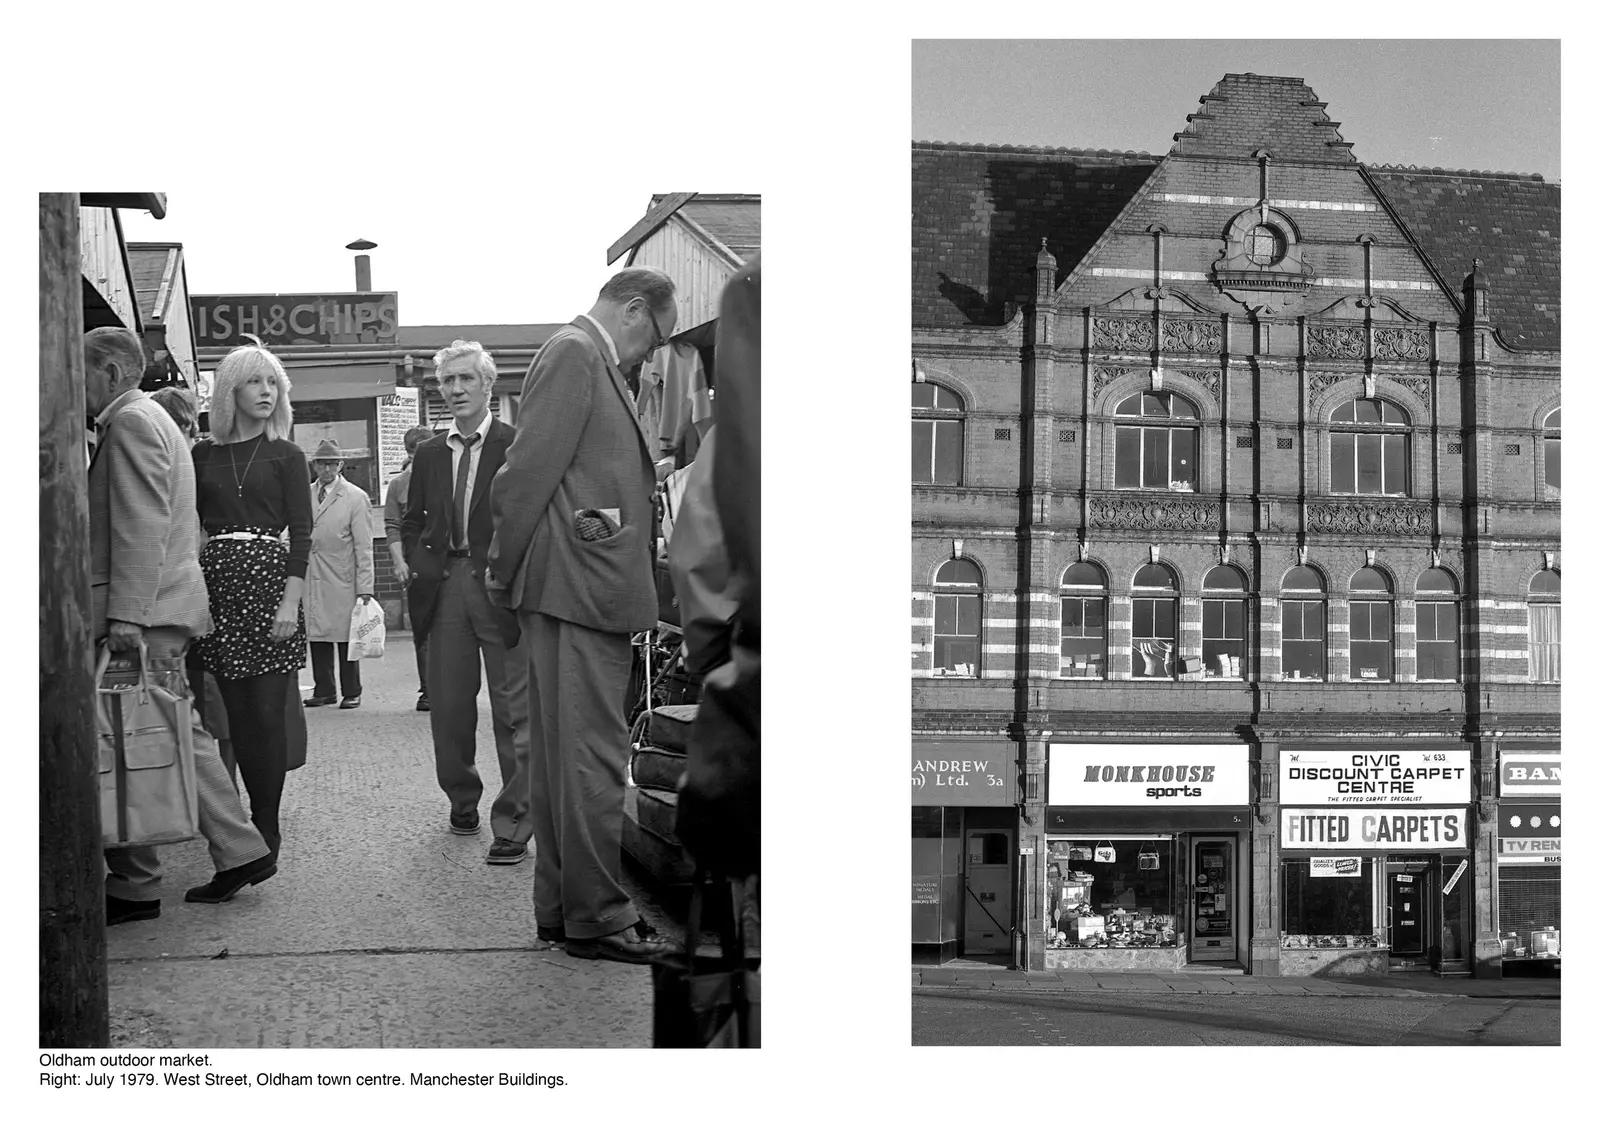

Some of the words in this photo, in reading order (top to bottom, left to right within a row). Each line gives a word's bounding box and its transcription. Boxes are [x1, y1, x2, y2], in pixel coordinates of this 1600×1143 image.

[199, 303, 397, 339] ISH&CHIPS
[913, 760, 989, 772] ANDREW
[1352, 754, 1400, 767] CIVIC
[1083, 765, 1216, 782] MONKHOUSE
[1289, 768, 1384, 780] DISCOUNT
[1390, 768, 1465, 780] CARPET
[936, 774, 969, 786] Ltd.
[986, 774, 1004, 786] 3a
[1146, 785, 1202, 800] sports
[1337, 781, 1414, 793] CENTRE
[1289, 815, 1349, 842] FITTED
[1361, 815, 1459, 842] CARPETS
[1506, 841, 1528, 851] TV
